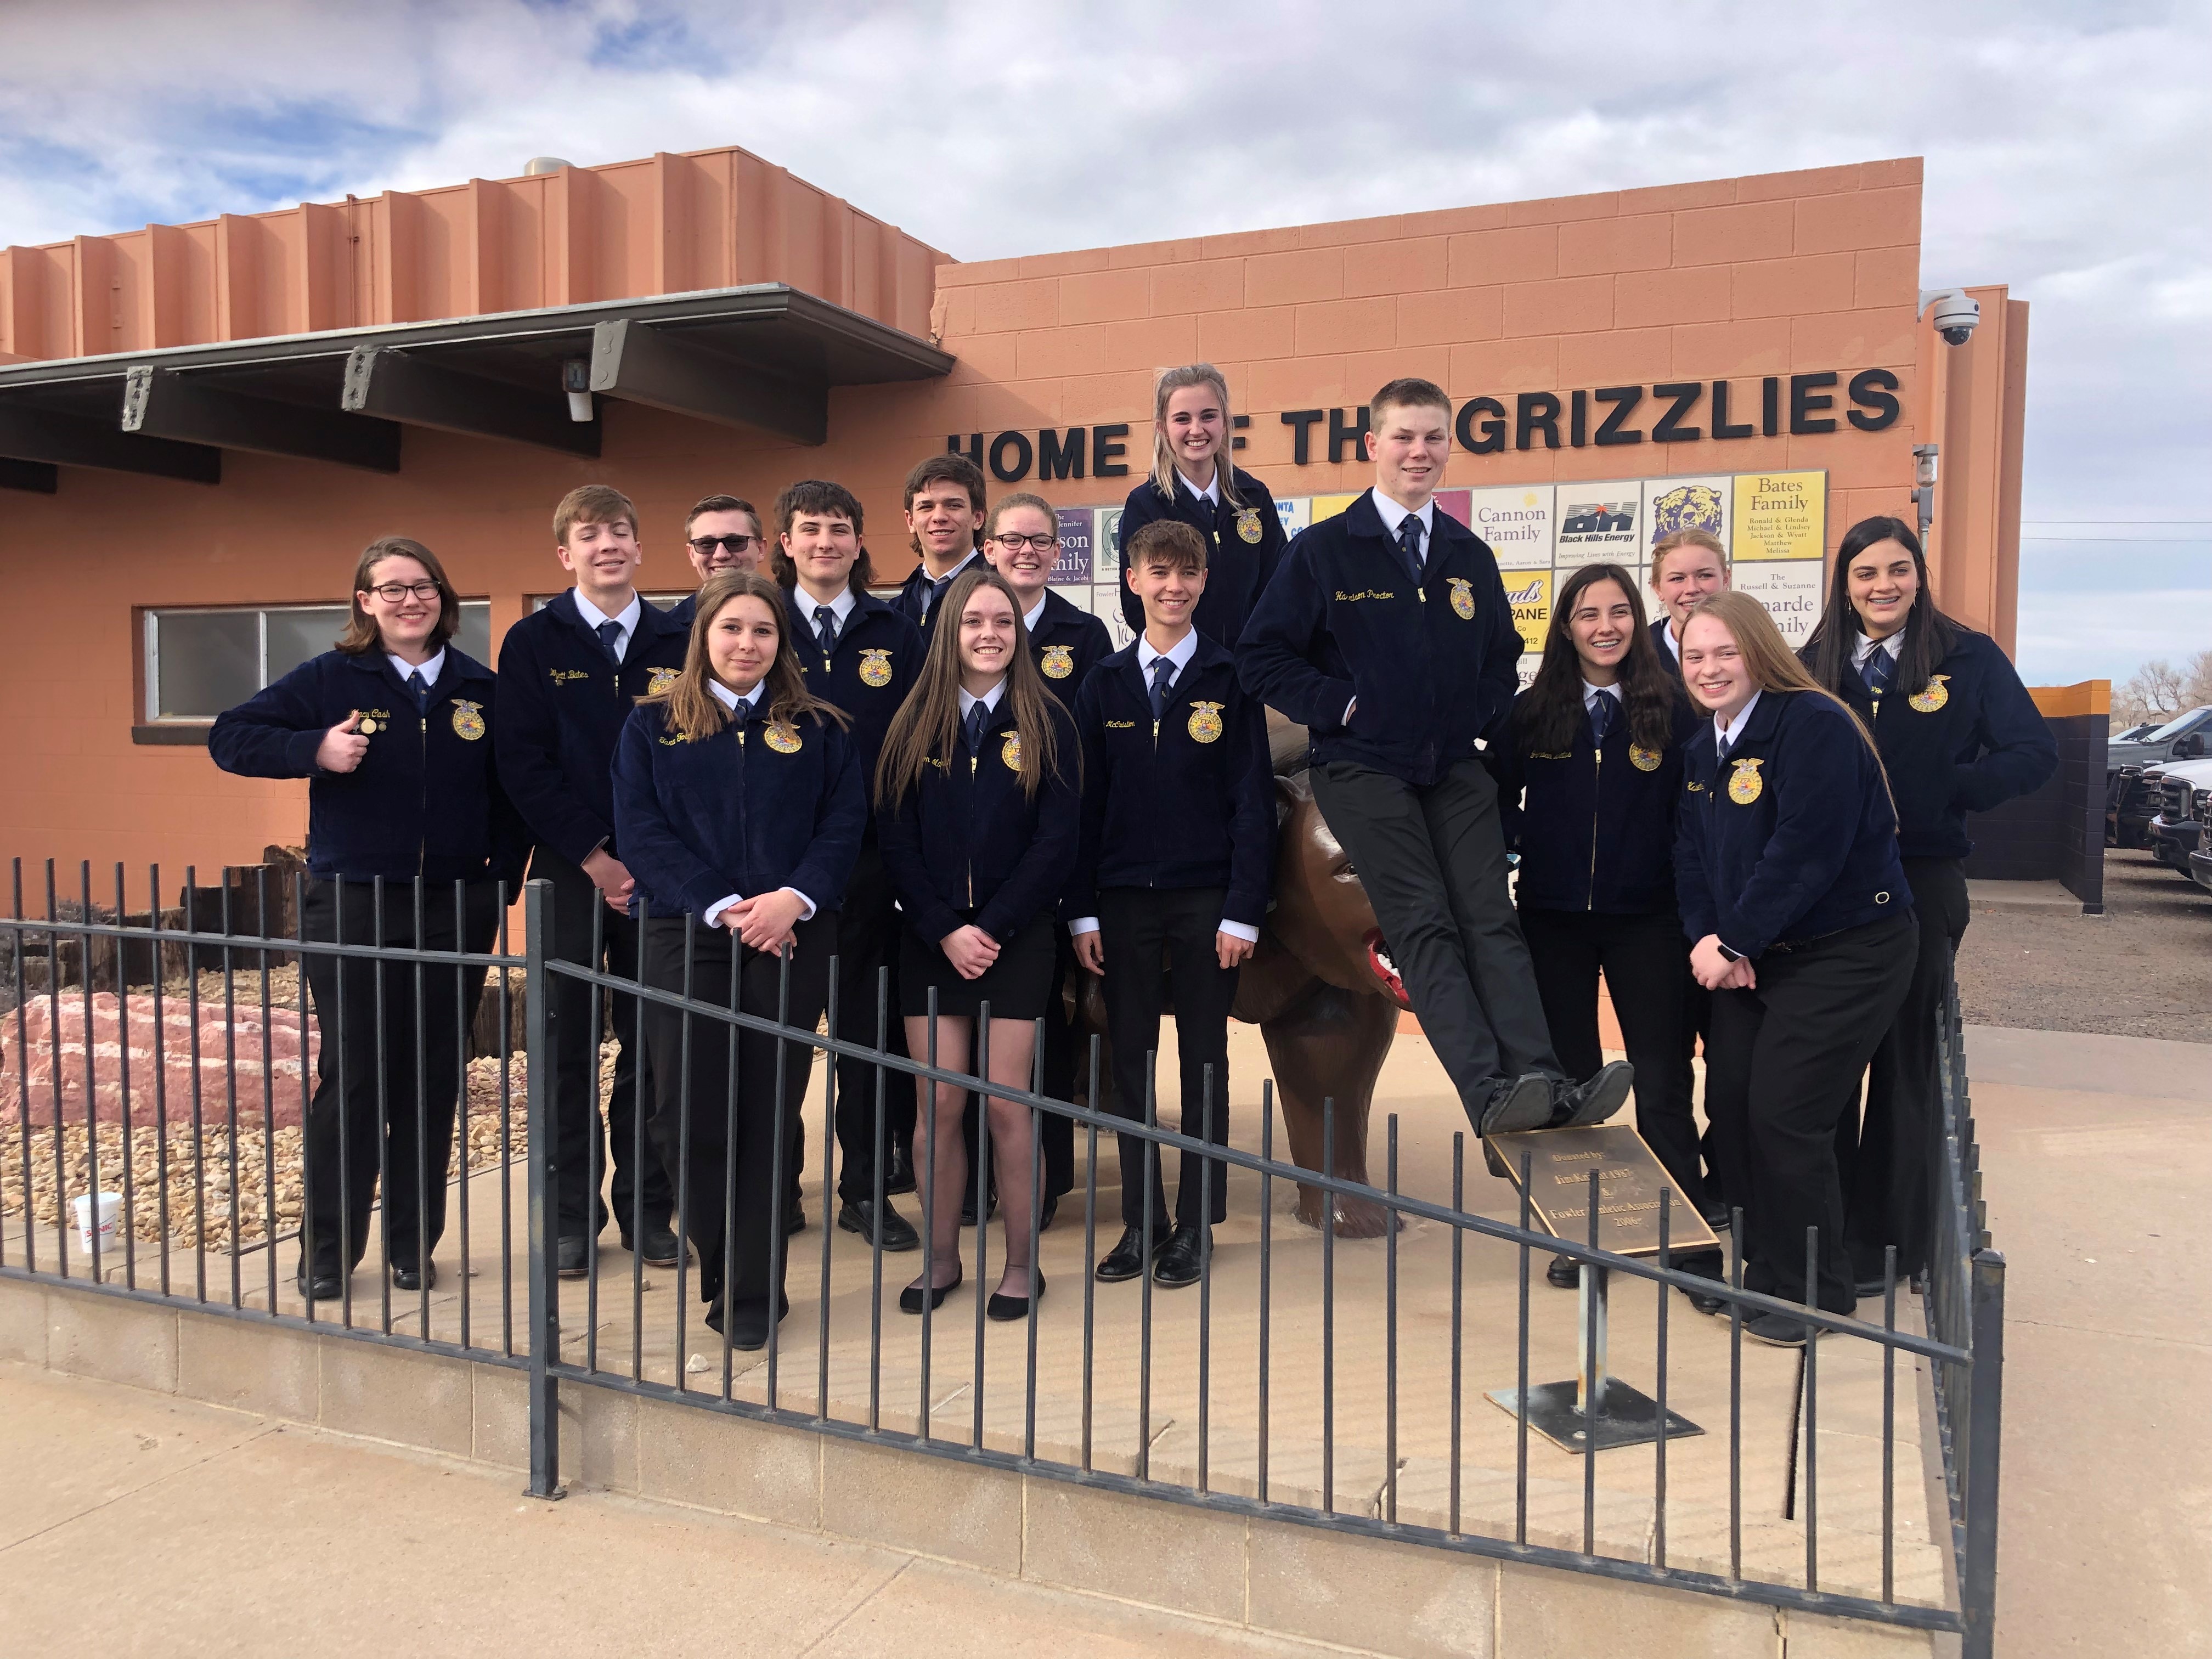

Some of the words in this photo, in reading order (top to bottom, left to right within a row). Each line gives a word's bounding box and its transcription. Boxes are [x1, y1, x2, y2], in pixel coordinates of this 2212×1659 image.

[948, 424, 1128, 482] HOME
[1281, 407, 1370, 465] TH
[1455, 369, 1900, 455] GRIZZLIES
[1758, 478, 1803, 493] Bates
[1751, 494, 1809, 512] Family
[1478, 507, 1547, 522] Cannon
[1562, 501, 1638, 533] BH
[1482, 524, 1541, 543] Family
[1559, 534, 1583, 543] Black
[1584, 533, 1603, 542] Hills
[1604, 533, 1635, 542] Energy
[371, 708, 391, 718] Cash
[1552, 1151, 1590, 1163] Donated
[1555, 1175, 1574, 1184] Jim
[1600, 1187, 1613, 1198] &
[1549, 1207, 1586, 1220] Fowler
[1613, 1216, 1639, 1227] 2006
[86, 1222, 112, 1237] SNIC
